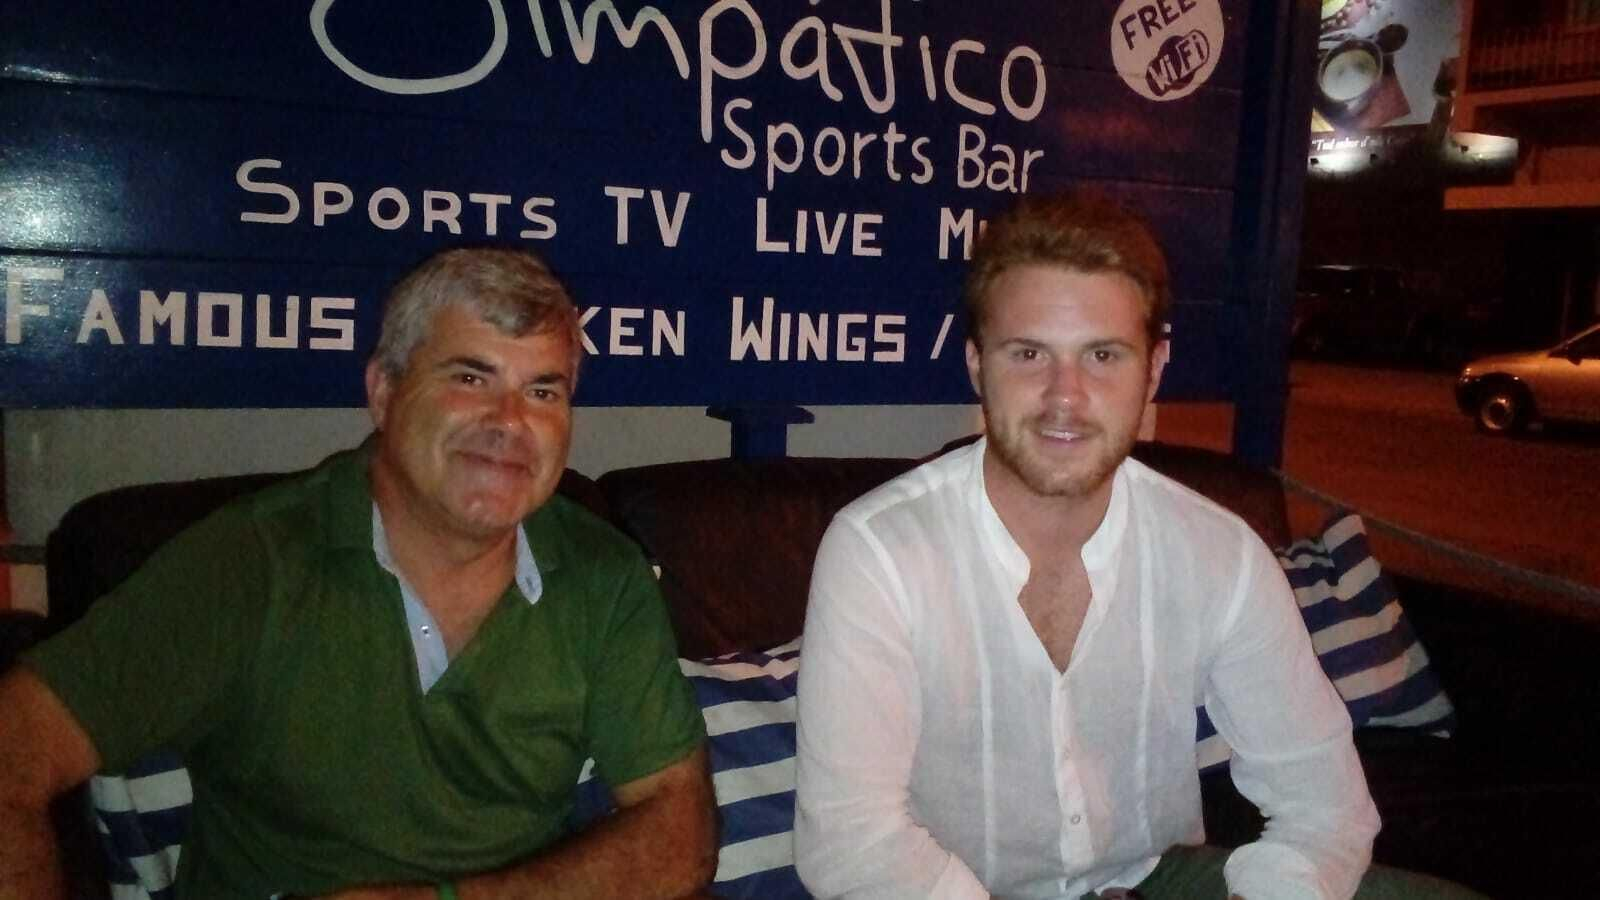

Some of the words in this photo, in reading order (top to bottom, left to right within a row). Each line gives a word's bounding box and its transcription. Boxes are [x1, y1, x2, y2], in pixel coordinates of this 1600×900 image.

[721, 98, 933, 191] Sports
[957, 123, 1044, 193] Bar
[236, 158, 557, 240] SPORTS
[605, 186, 690, 247] TV
[756, 198, 883, 256] LIVE
[5, 266, 355, 350] FAMOUS
[574, 306, 686, 356] KEN
[730, 297, 906, 362] WINGS
